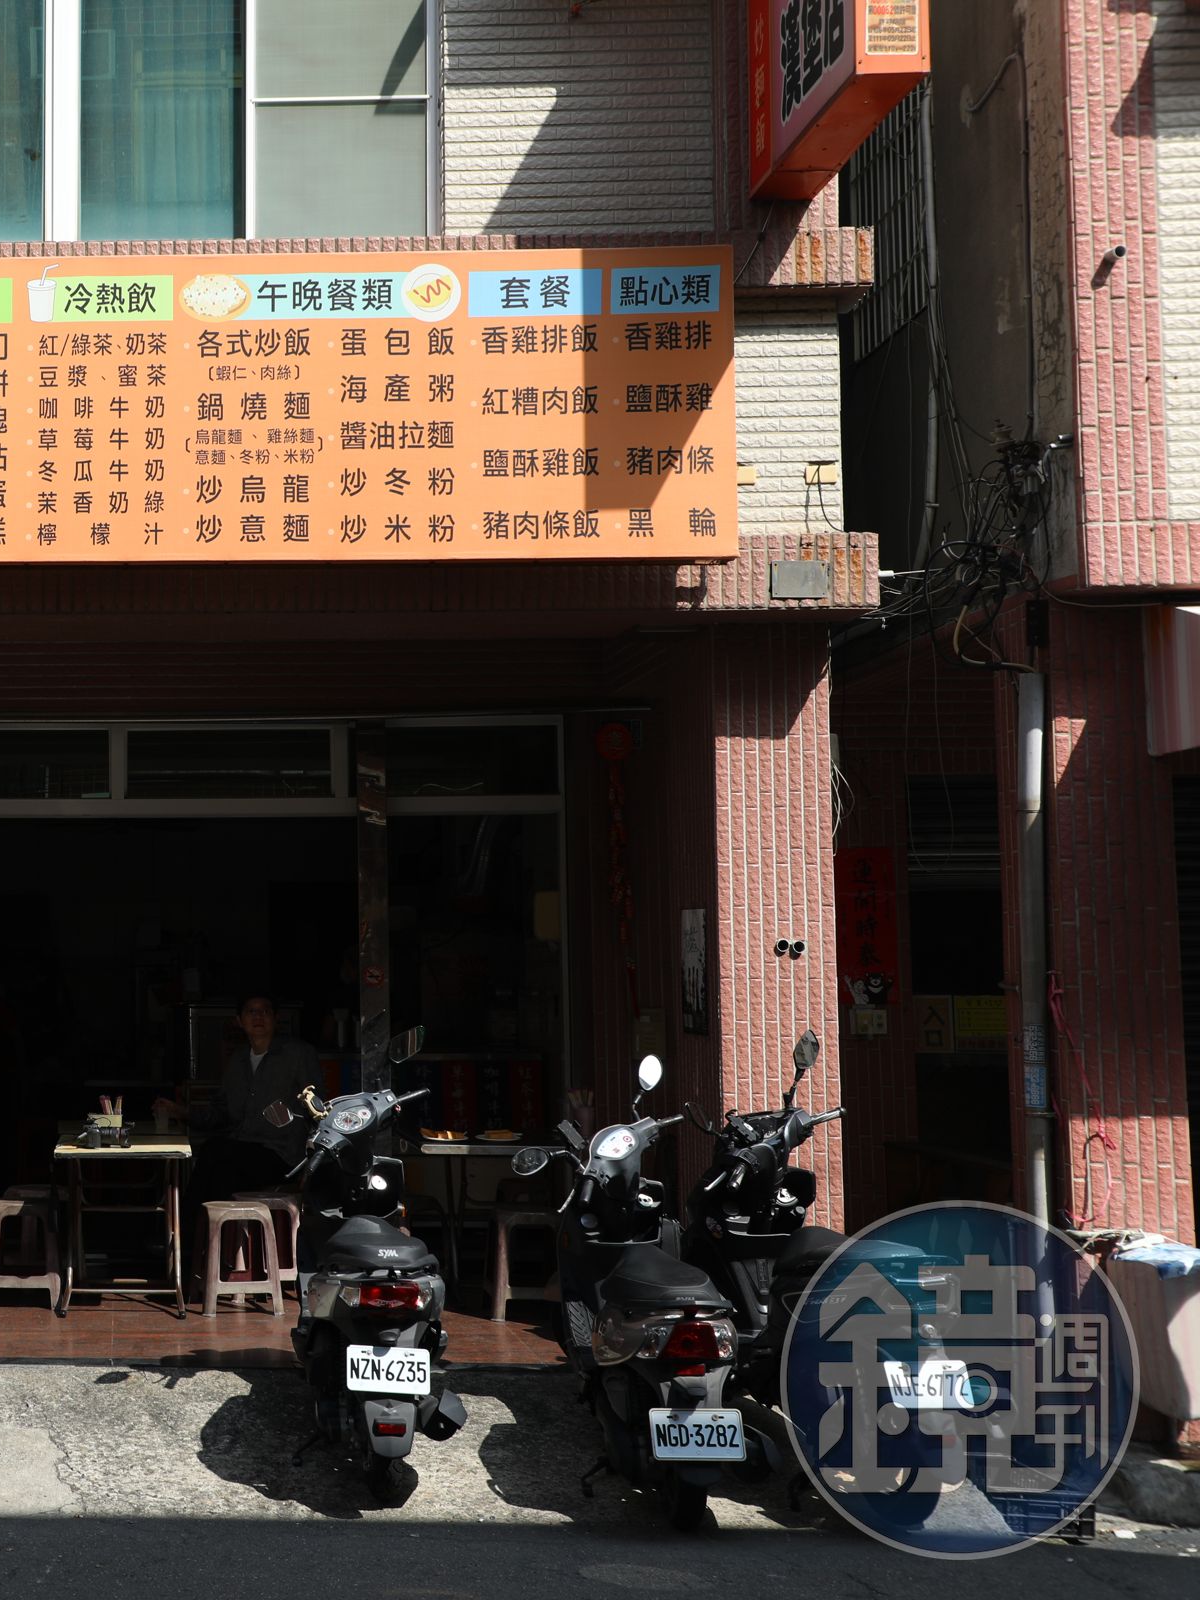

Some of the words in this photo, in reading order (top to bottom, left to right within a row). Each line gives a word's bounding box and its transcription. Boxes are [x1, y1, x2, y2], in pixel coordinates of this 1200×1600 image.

[63, 282, 157, 315] 冷熱飲
[256, 278, 394, 313] 午晚餐類
[499, 274, 571, 309] 套餐
[619, 273, 712, 307] 點心類
[196, 327, 311, 359] 各式炒飯
[340, 326, 455, 357] 蛋包飯
[481, 323, 599, 355] 香雞排飯
[624, 319, 713, 352] 香雞排
[340, 373, 454, 404] 海產粥
[481, 385, 599, 416] 紅糟肉飯
[625, 382, 713, 414] 鹽酥雞
[38, 395, 165, 420] 咖啡牛奶
[197, 391, 311, 422] 鍋燒麵
[37, 427, 165, 452] 草莓牛奶
[339, 420, 455, 451] 醬油拉麵
[37, 458, 165, 483] 冬瓜牛奶
[482, 447, 600, 478] 鹽酥雞飯
[625, 444, 714, 476] 豬肉條
[196, 473, 310, 505] 炒烏龍
[340, 467, 455, 497] 炒冬粉
[37, 489, 165, 515] 茉香奶綠
[195, 513, 310, 544] 炒意麵
[340, 513, 456, 544] 炒米粉
[482, 509, 601, 540] 豬肉條飯
[923, 1005, 945, 1047] 入口
[377, 1249, 399, 1259] SYM
